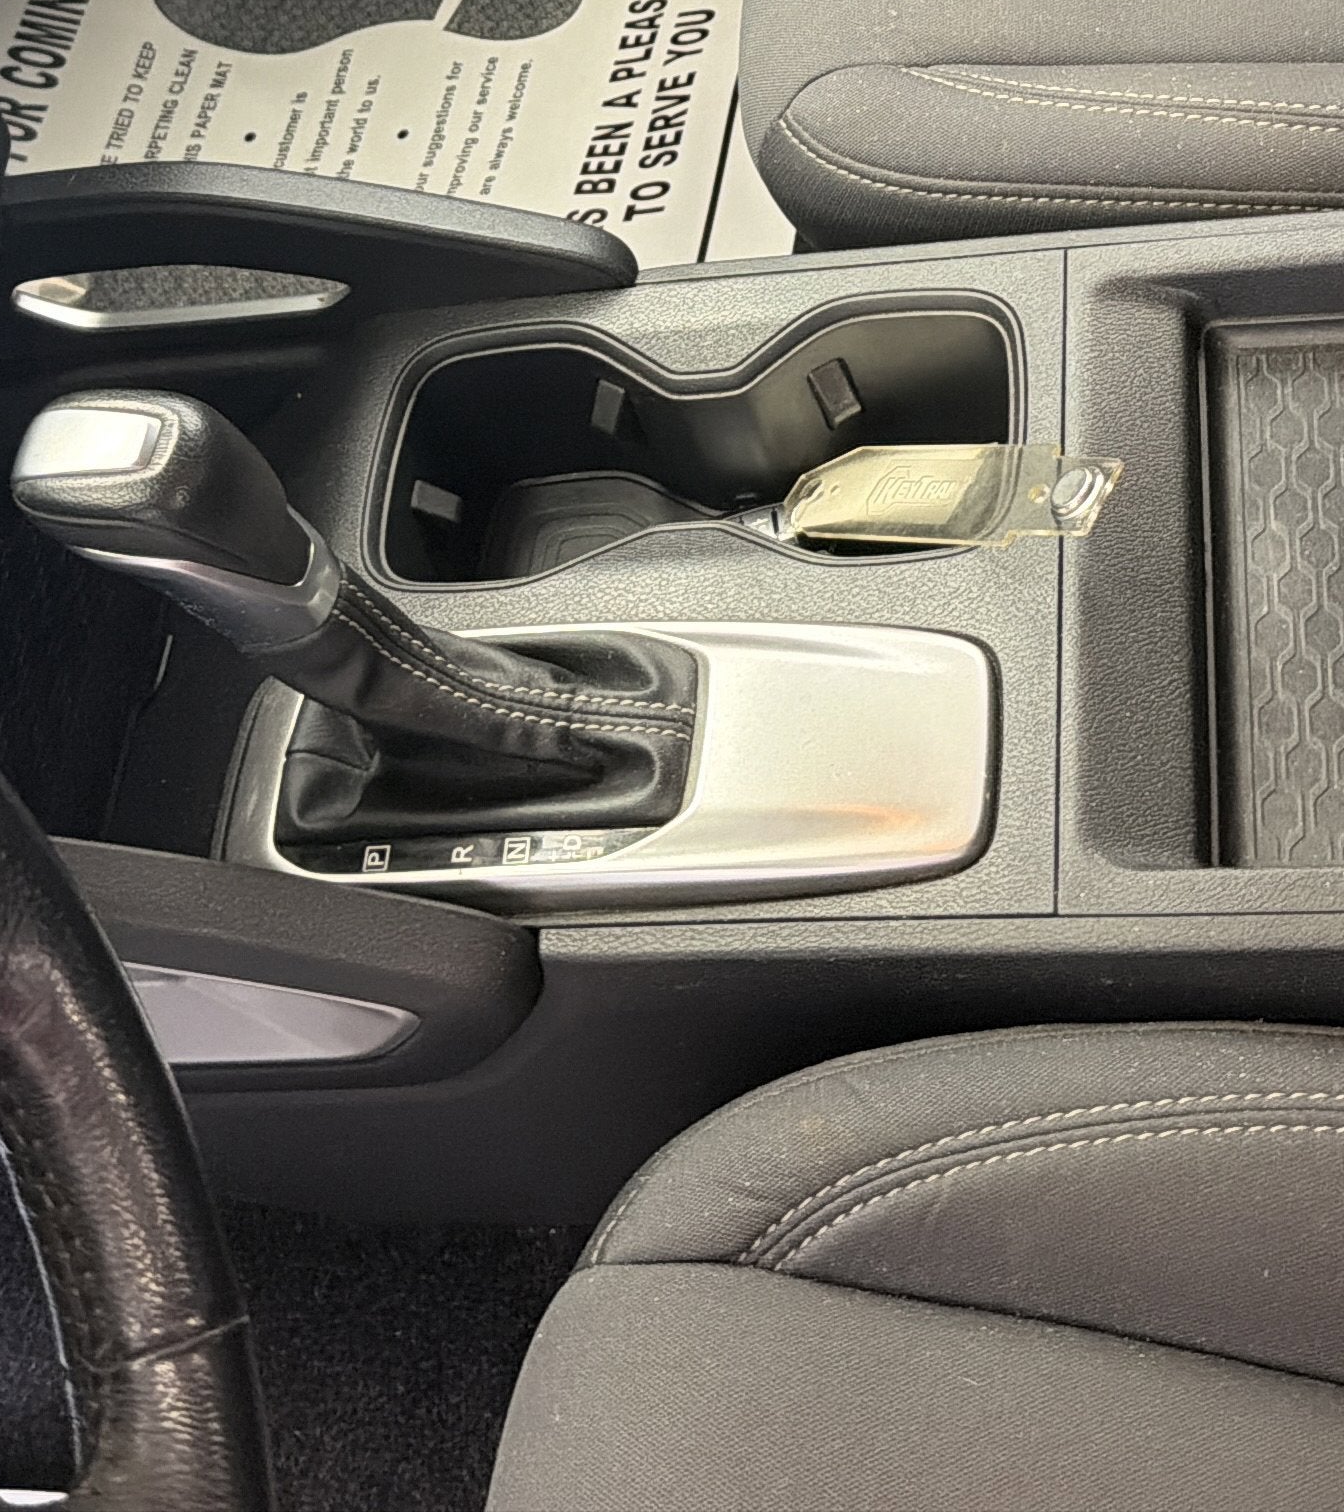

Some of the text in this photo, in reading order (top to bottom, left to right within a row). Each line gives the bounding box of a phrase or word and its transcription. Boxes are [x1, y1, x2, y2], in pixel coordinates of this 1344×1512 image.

[105, 107, 135, 150] TRIED
[123, 82, 143, 103] TO
[133, 41, 157, 81] KEEP
[144, 47, 198, 160] RPETING CLEAN
[192, 92, 221, 138] PAPER
[213, 60, 232, 90] MAT
[304, 98, 340, 162] important
[331, 48, 354, 96] person
[357, 98, 373, 115] to
[422, 85, 456, 168] suggestions
[446, 60, 464, 84] for
[476, 56, 499, 106] service
[600, 88, 642, 109] A
[622, 9, 716, 223] TO SERVE YOU
[273, 90, 308, 168] customer is
[349, 117, 368, 155] world
[468, 109, 485, 134] our
[479, 57, 534, 196] are always welcome.
[573, 120, 634, 195] BEEN
[451, 843, 475, 863] R
